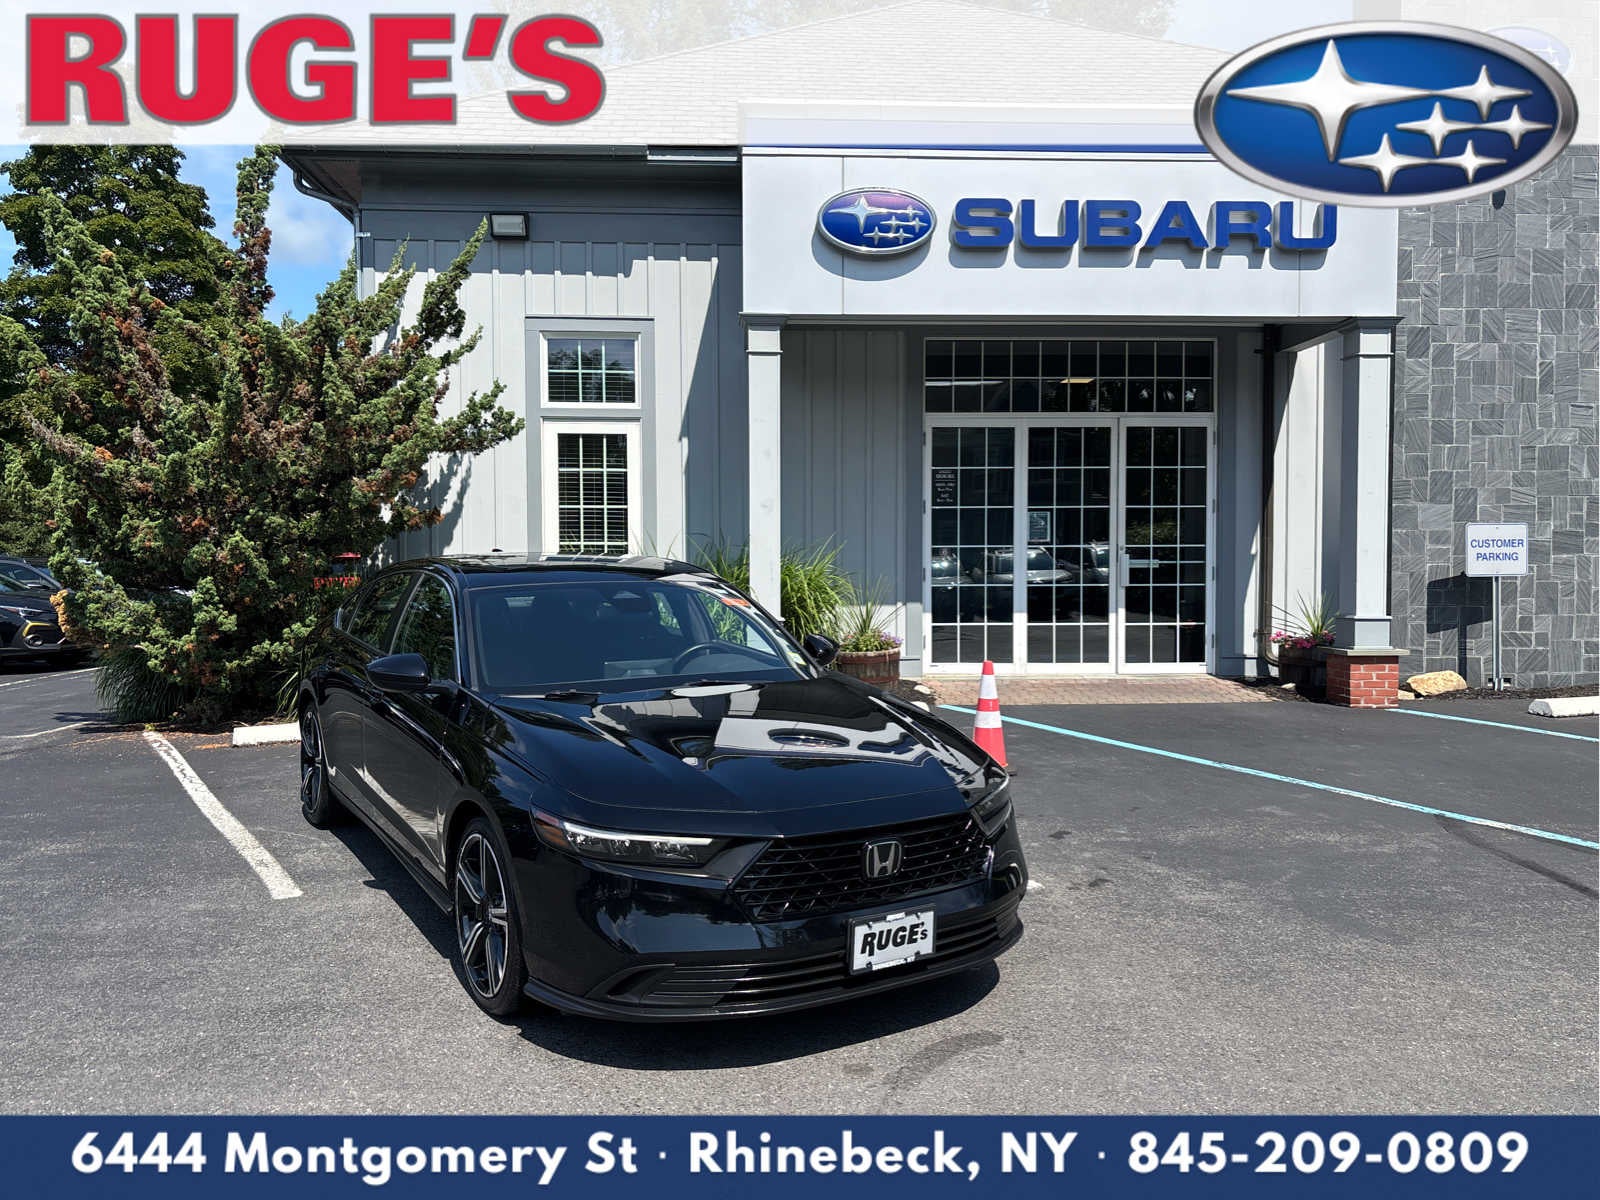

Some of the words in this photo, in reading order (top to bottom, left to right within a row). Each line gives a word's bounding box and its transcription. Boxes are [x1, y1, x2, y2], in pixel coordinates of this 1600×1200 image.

[952, 197, 1338, 251] SUBARU
[1470, 538, 1524, 549] CUSTOMER
[1476, 552, 1519, 561] PARKING
